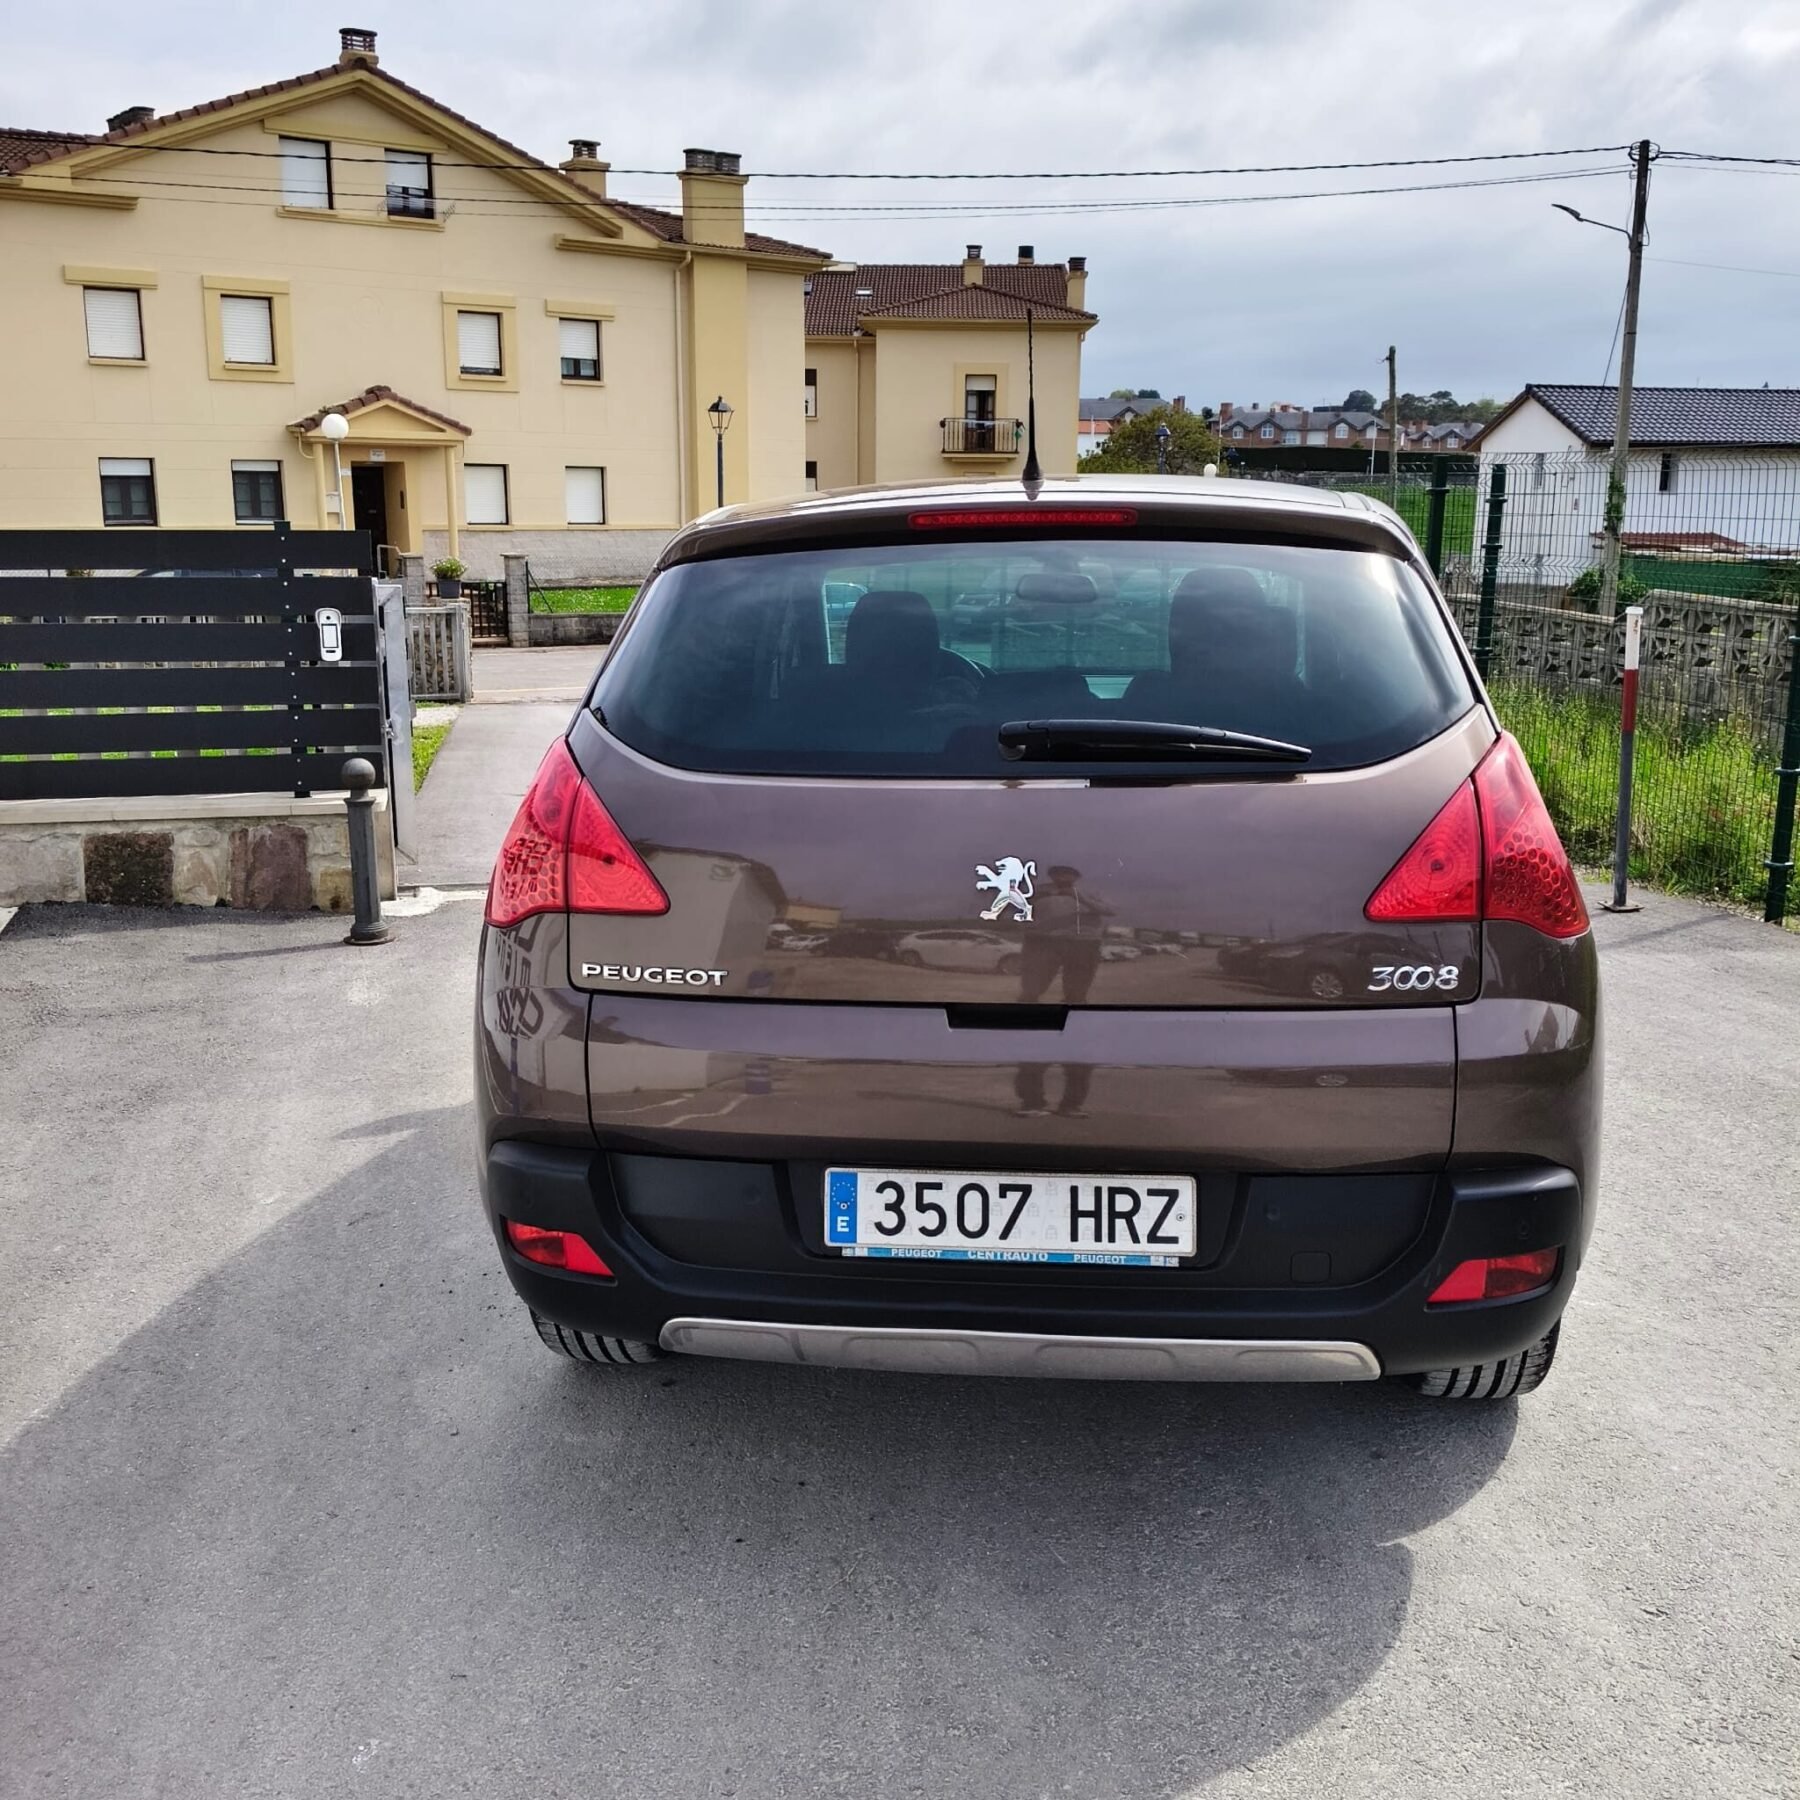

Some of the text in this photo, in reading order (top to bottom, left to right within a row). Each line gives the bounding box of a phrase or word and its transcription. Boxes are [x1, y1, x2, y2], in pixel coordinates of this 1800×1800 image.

[581, 962, 728, 986] PEUGEOT
[1367, 965, 1460, 991] 3008
[837, 1215, 850, 1232] E
[873, 1181, 1180, 1245] 3507 HRZ
[891, 1248, 1127, 1265] PEUGEOT CENTRAUTO PEUGEOT
